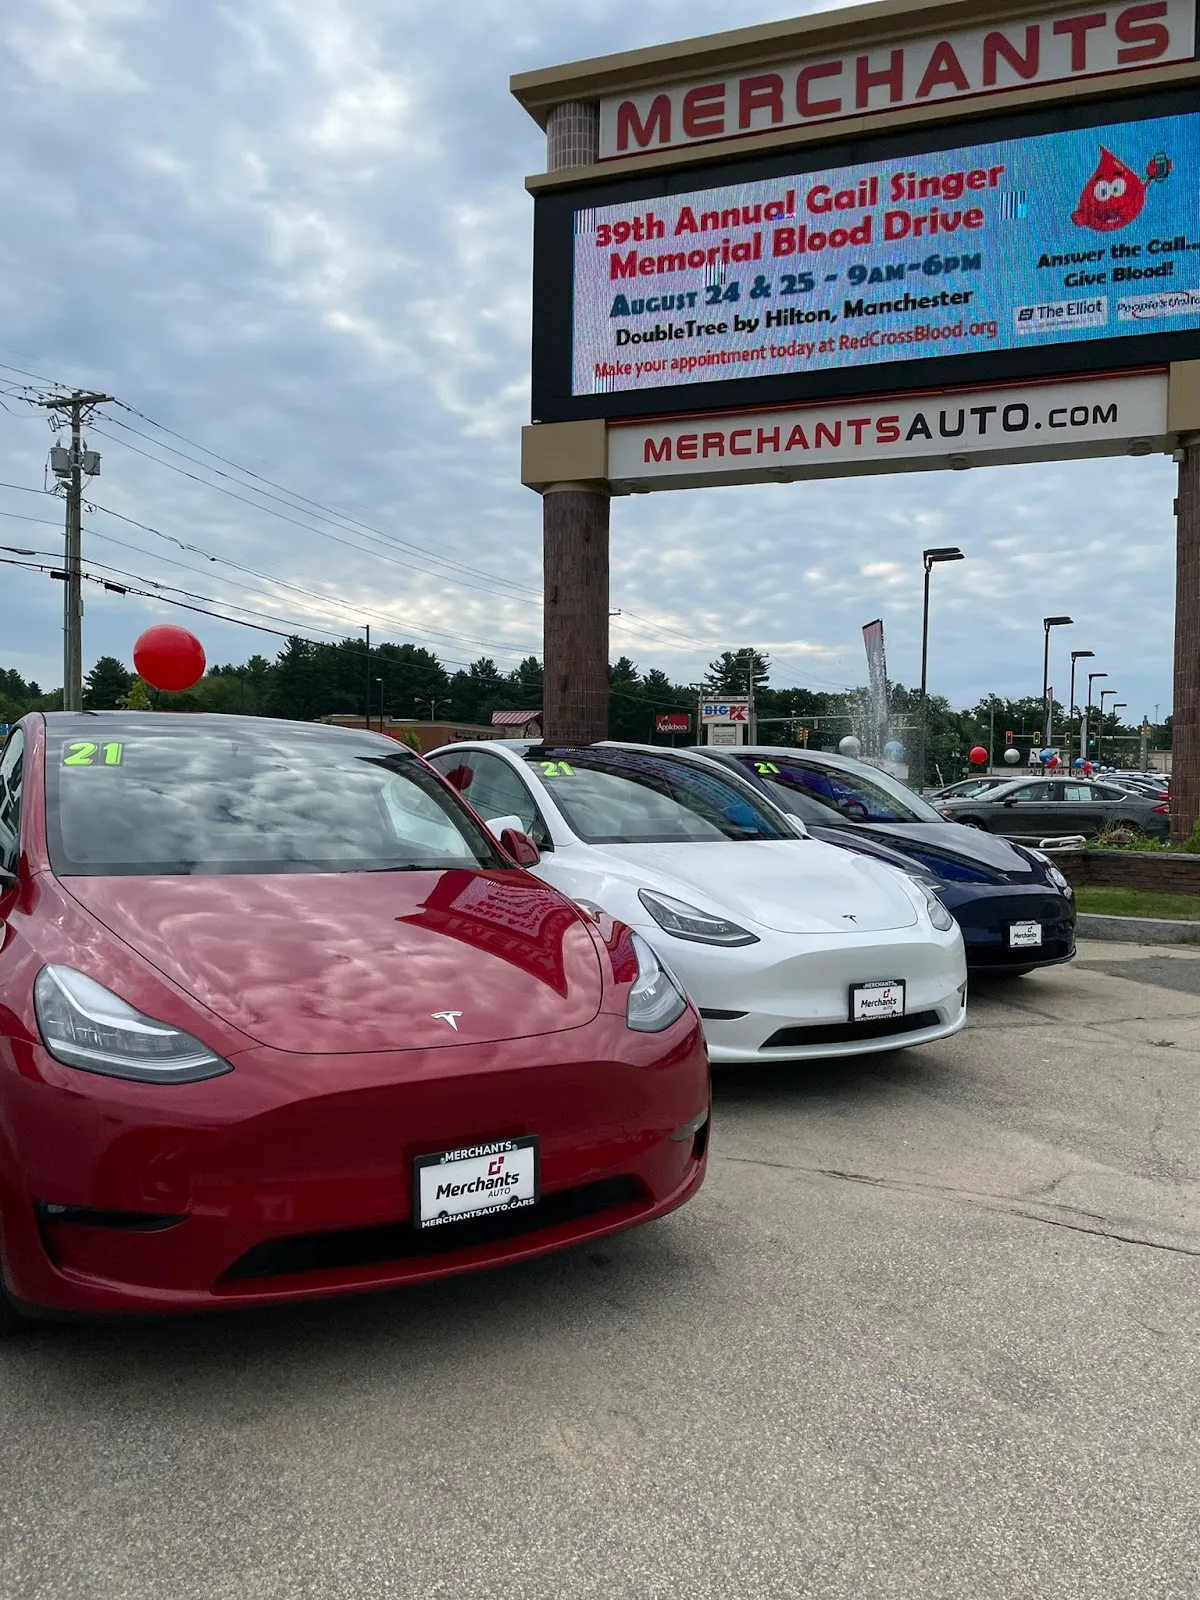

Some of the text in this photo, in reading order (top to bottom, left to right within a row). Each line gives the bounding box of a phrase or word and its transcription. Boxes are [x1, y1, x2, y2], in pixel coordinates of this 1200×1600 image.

[616, 1, 1169, 151] MERCHANTS
[595, 165, 1005, 247] 39th Annual Gail Singer
[609, 207, 984, 280] Memorial Blood Drive
[1037, 249, 1105, 268] Answer
[1111, 243, 1141, 258] the
[1064, 261, 1174, 287] Give Blood!
[705, 281, 740, 305] 24
[750, 275, 771, 299] &
[780, 272, 815, 295] 25
[616, 290, 974, 346] DoubleTree by Hilton, Manchester
[1037, 300, 1102, 319] The Elliot
[595, 320, 998, 378] Make your appointment today at RedCrossBlood.org
[705, 705, 747, 720] BIG K
[64, 742, 122, 765] 21
[540, 761, 575, 776] 21
[754, 762, 780, 774] 21
[864, 981, 896, 989] MERCHANTS
[861, 997, 897, 1008] Merchants
[445, 1141, 512, 1162] MERCHANTS
[435, 1171, 520, 1200] Merchants
[487, 1187, 511, 1199] AUTO
[421, 1198, 535, 1229] MERCHANTSAUTO.CARS
